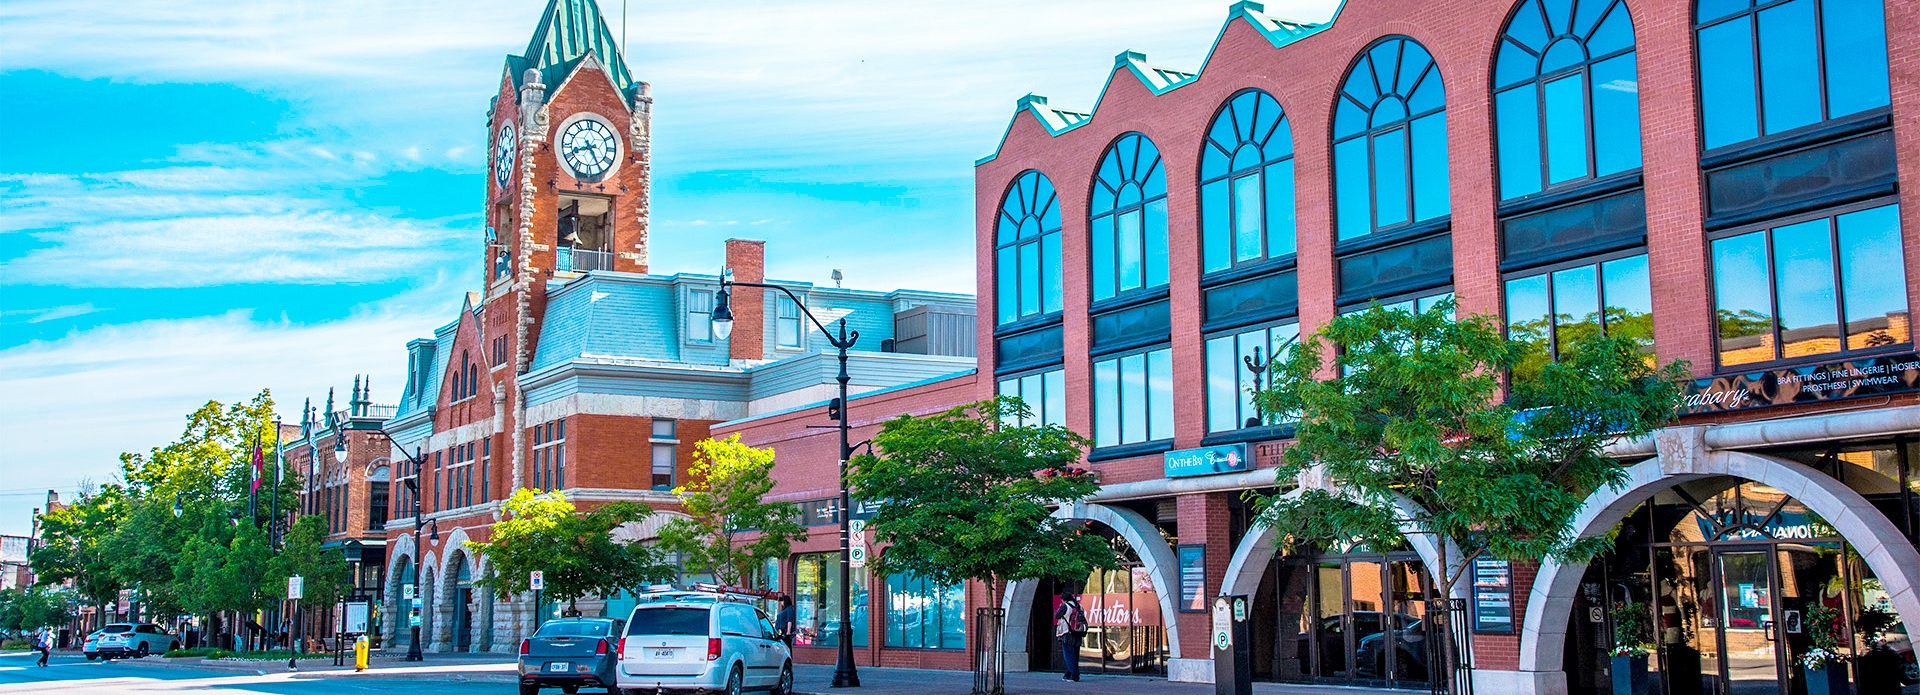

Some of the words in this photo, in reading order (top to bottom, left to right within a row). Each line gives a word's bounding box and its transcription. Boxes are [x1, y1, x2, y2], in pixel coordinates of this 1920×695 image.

[1777, 377, 1792, 385] BRA
[1792, 372, 1827, 382] FITTINGS
[1832, 370, 1848, 379] FINE
[1850, 364, 1885, 377] LINGERIE
[1891, 360, 1920, 372] HOSIER
[1802, 380, 1847, 392] PROSTHESIS
[1852, 376, 1898, 388] SWIMWEAR
[1673, 386, 1749, 409] rabary
[1192, 454, 1204, 466] BAY
